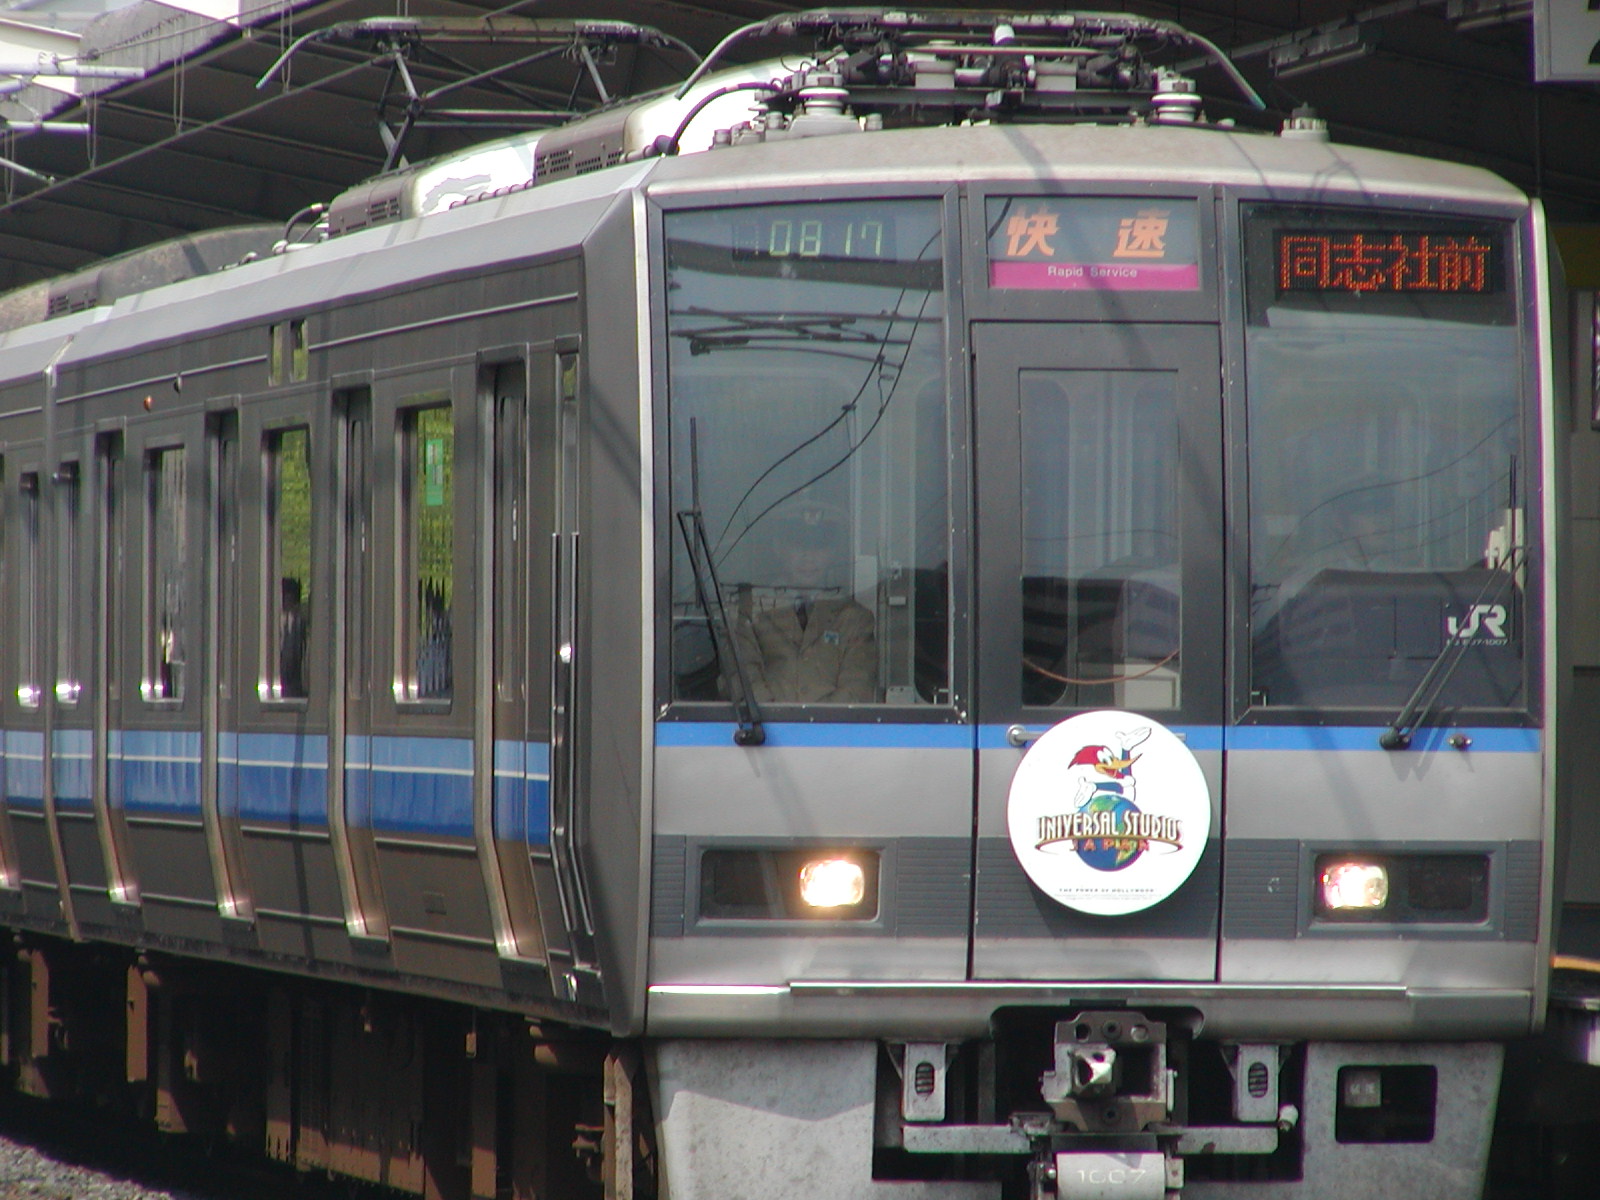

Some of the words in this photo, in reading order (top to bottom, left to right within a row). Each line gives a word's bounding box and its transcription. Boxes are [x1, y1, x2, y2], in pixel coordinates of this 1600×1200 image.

[1006, 207, 1171, 257] 快速
[1047, 265, 1083, 279] Rapid
[1090, 266, 1137, 278] Service
[1280, 233, 1491, 291] 同志社前
[1447, 603, 1507, 638] JR
[1037, 810, 1119, 842] UNIVERSAL
[1122, 809, 1184, 843] STUDIOS
[1069, 838, 1149, 852] JAPAN
[1077, 1168, 1146, 1185] 1007
